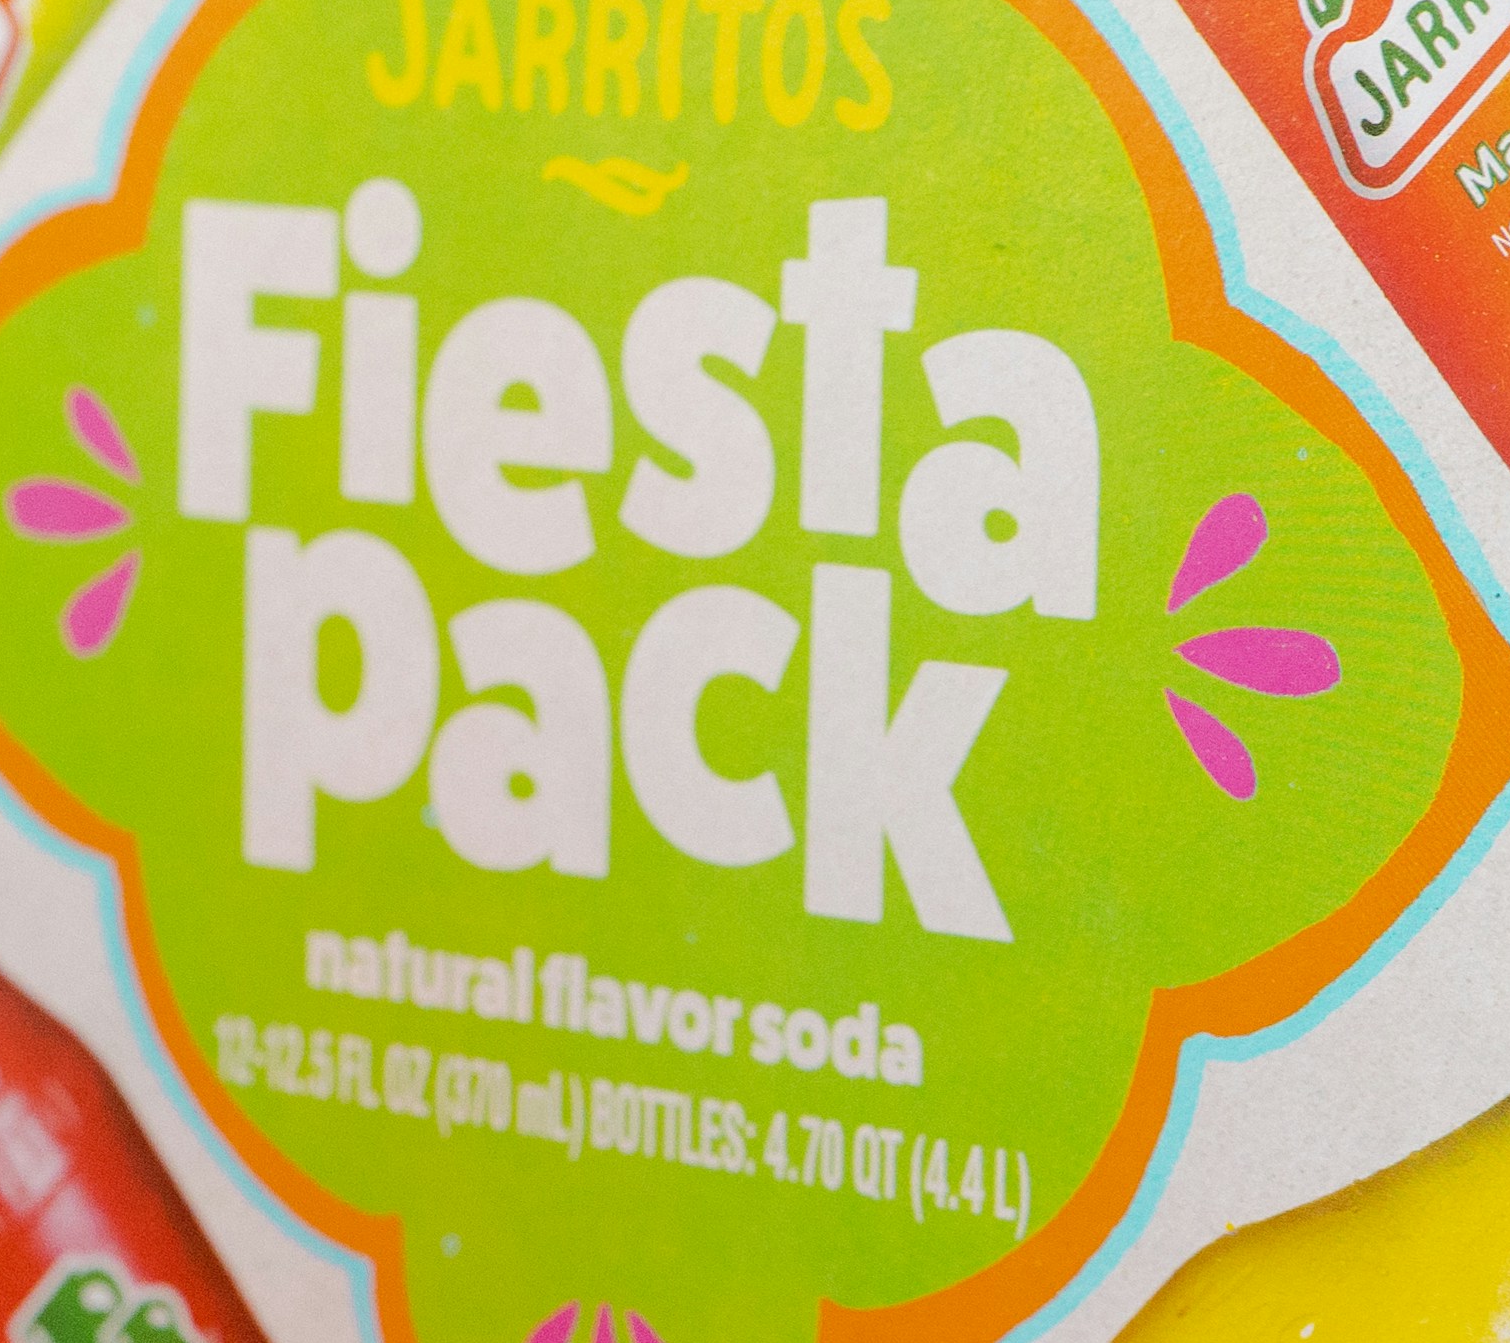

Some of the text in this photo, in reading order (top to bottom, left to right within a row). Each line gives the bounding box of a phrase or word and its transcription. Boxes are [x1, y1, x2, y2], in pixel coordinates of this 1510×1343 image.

[176, 177, 1100, 620] Fiesta
[242, 524, 1015, 943] pack
[305, 929, 924, 1087] natural flavor soda
[337, 1033, 378, 1109] FL
[383, 1042, 432, 1118] OZ
[591, 1078, 756, 1175] BOTTLES:
[763, 1112, 843, 1191] 4.70
[852, 1123, 903, 1200] QT
[911, 1135, 985, 1223] (4.4
[994, 1147, 1030, 1241] L)
